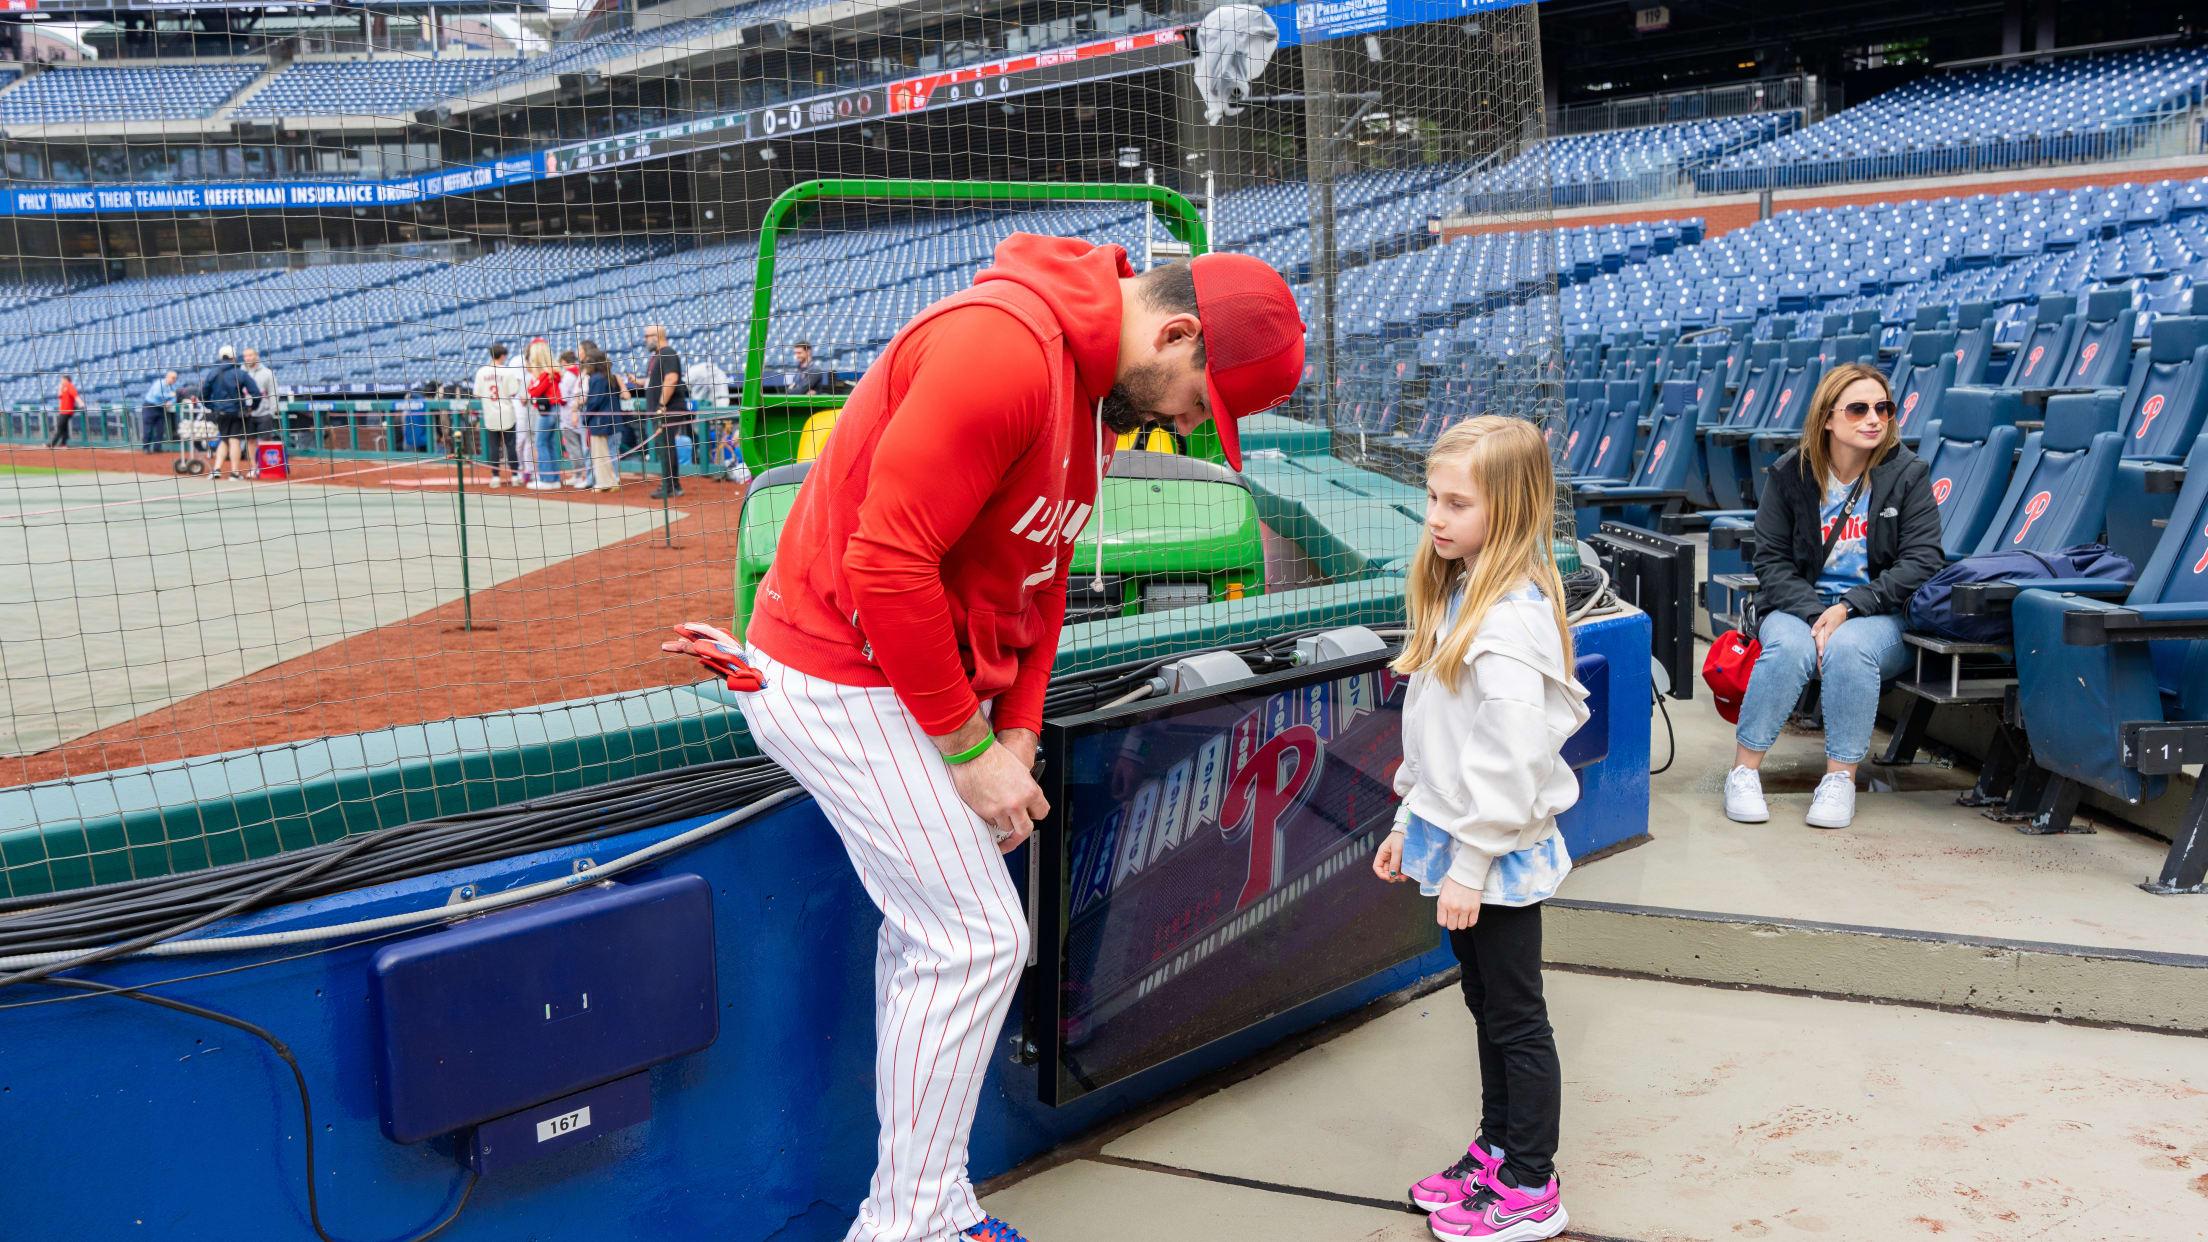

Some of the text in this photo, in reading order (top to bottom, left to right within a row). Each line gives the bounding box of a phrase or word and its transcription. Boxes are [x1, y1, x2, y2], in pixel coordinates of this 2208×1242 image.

[1644, 8, 1661, 24] 119
[974, 81, 985, 97] 0
[51, 190, 95, 209] THANKS
[98, 191, 133, 209] THEIR
[136, 188, 201, 208] TEAMMATE:
[204, 186, 286, 207] HEFFERNAN
[291, 185, 373, 204] INSURANCE
[2025, 346, 2045, 377] P
[2078, 342, 2099, 376] P
[489, 385, 499, 402] 3
[1774, 388, 1792, 419] P
[1899, 391, 1919, 428] P
[2136, 394, 2165, 439] P
[1648, 439, 1667, 474] P
[2013, 490, 2052, 545] P
[2160, 743, 2169, 760] 1
[1198, 745, 1216, 812] 1978
[1164, 768, 1183, 837] 1977
[1220, 723, 1319, 914] P
[1138, 962, 1169, 999] HOME
[1174, 951, 1189, 976] OF
[1194, 934, 1216, 963] THE
[1220, 873, 1310, 947] PHILADELPHIA
[1315, 831, 1375, 886] PHILLIES
[550, 1113, 579, 1135] 167
